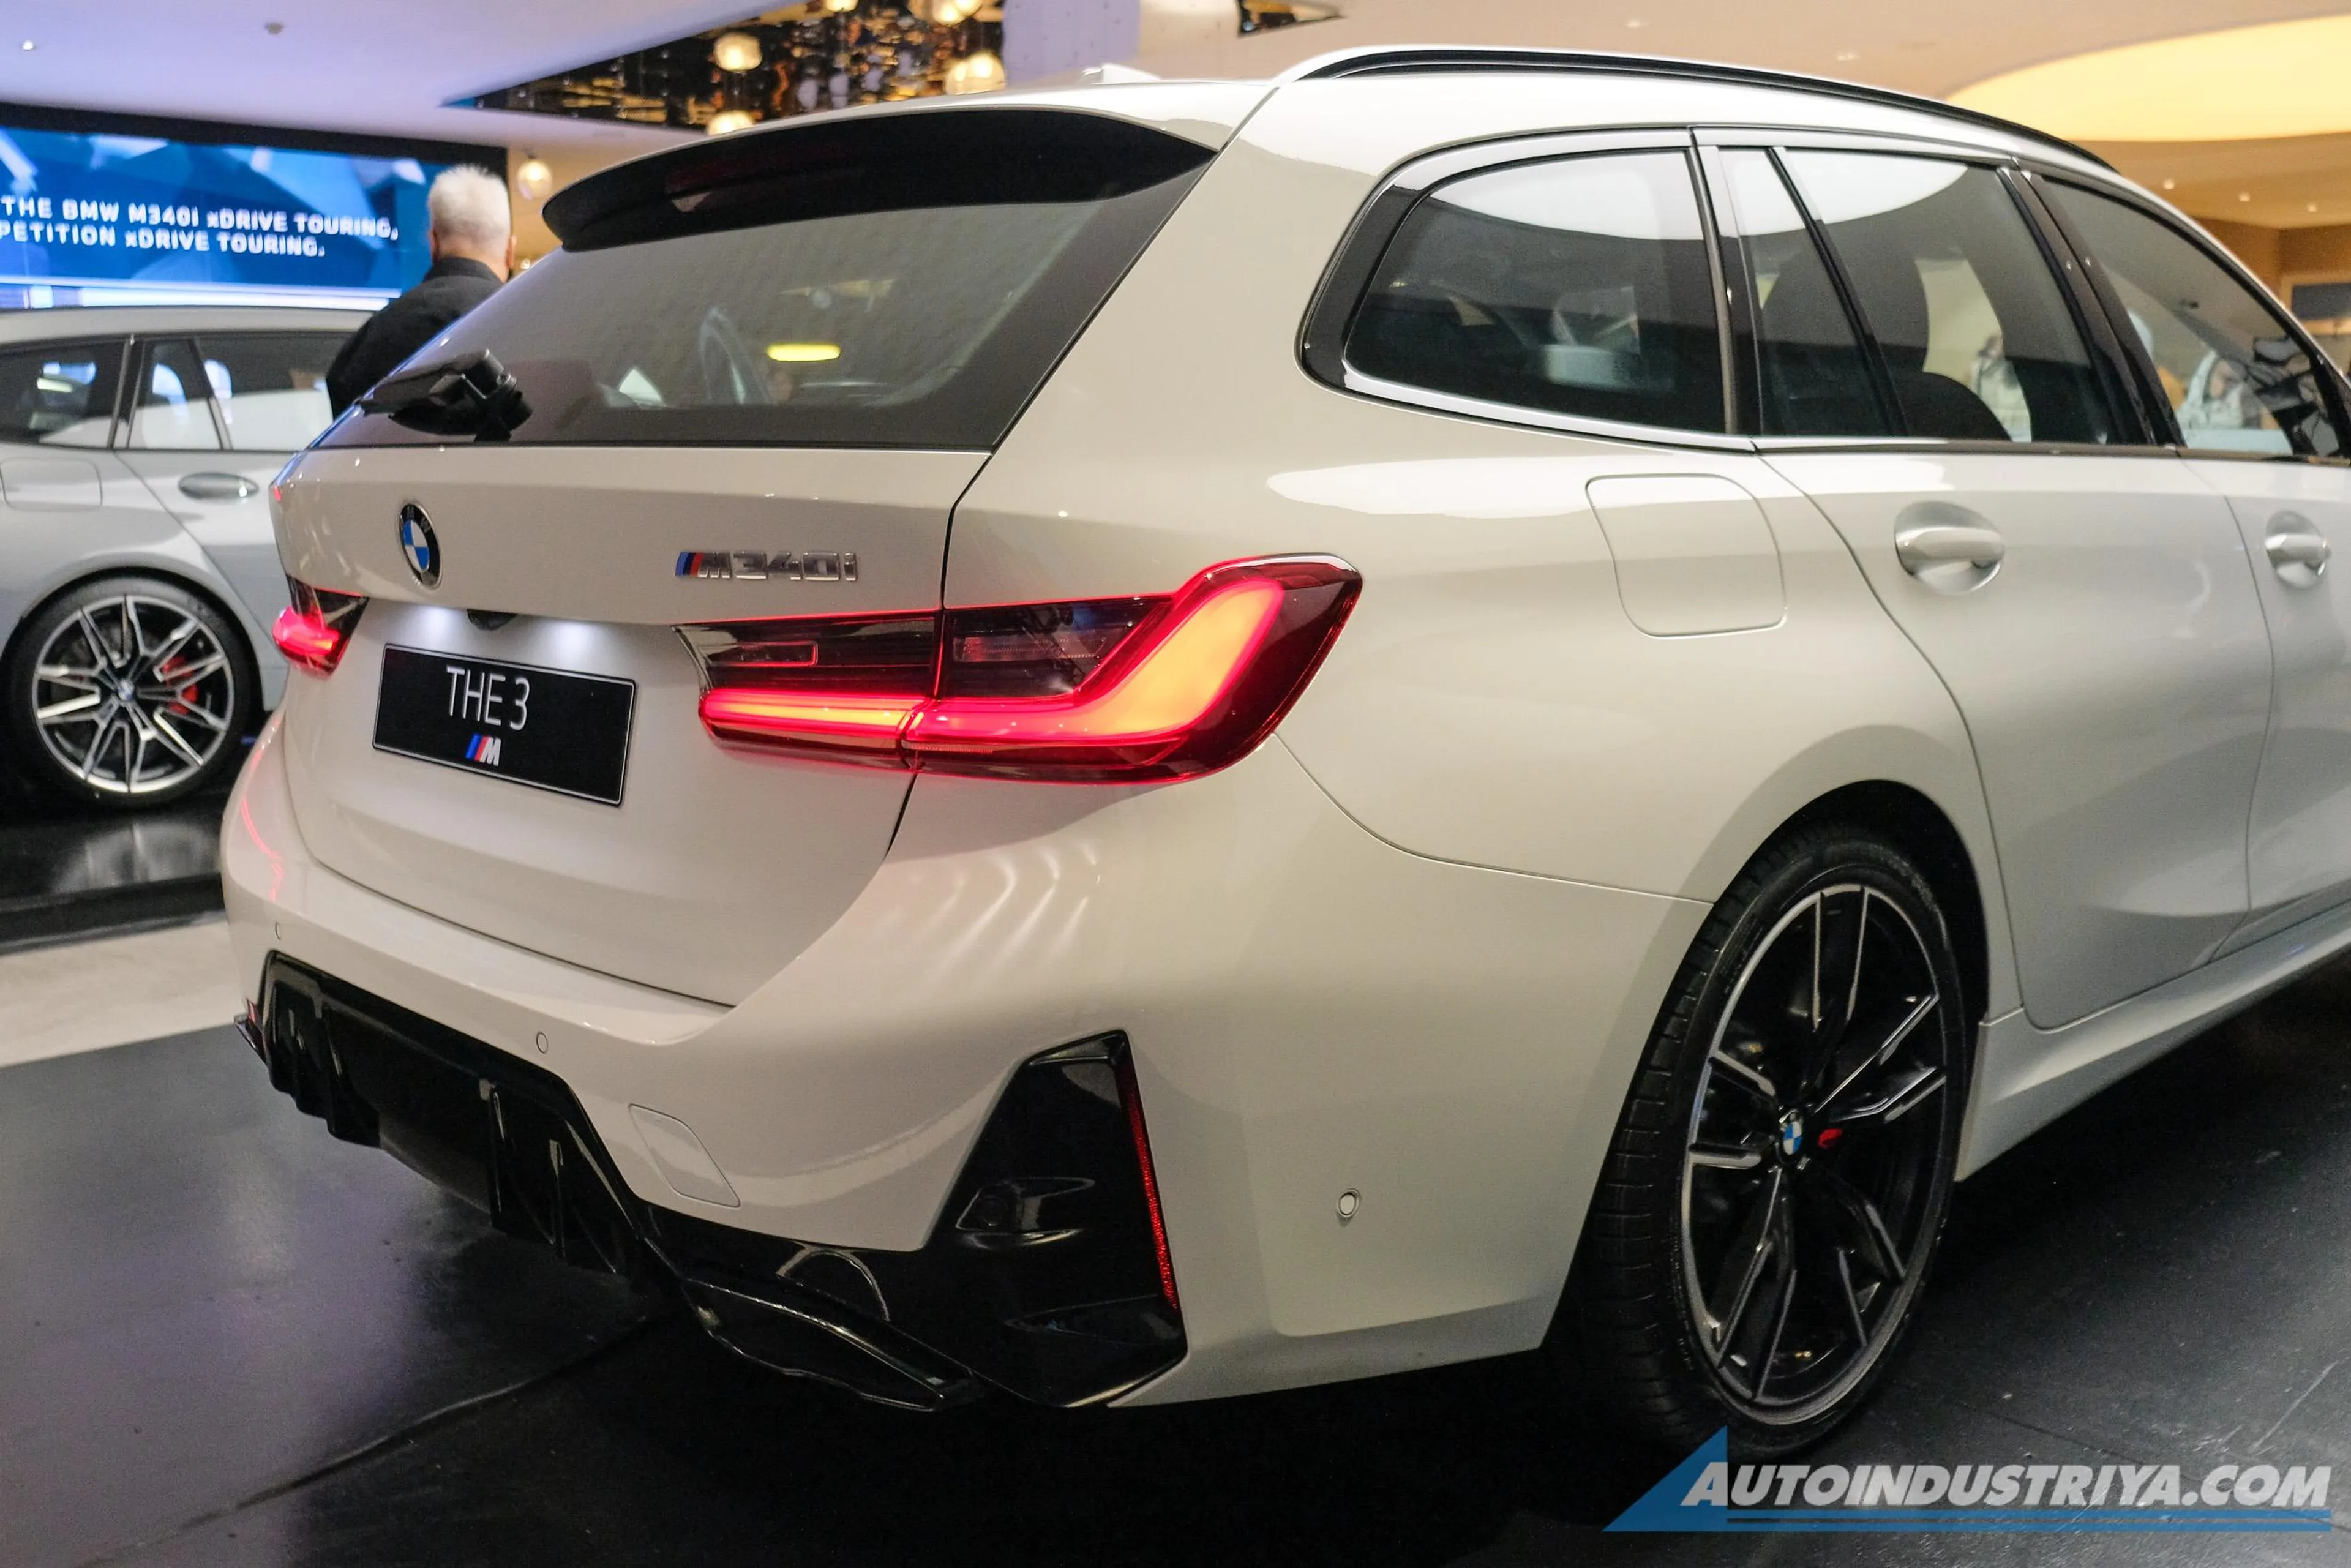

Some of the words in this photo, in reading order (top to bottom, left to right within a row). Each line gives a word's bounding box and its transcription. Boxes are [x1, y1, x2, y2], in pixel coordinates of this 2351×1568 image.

[1, 195, 53, 219] THE
[62, 198, 119, 222] BMW
[698, 551, 856, 581] M340i
[446, 665, 506, 727] THE
[509, 677, 530, 730] 3
